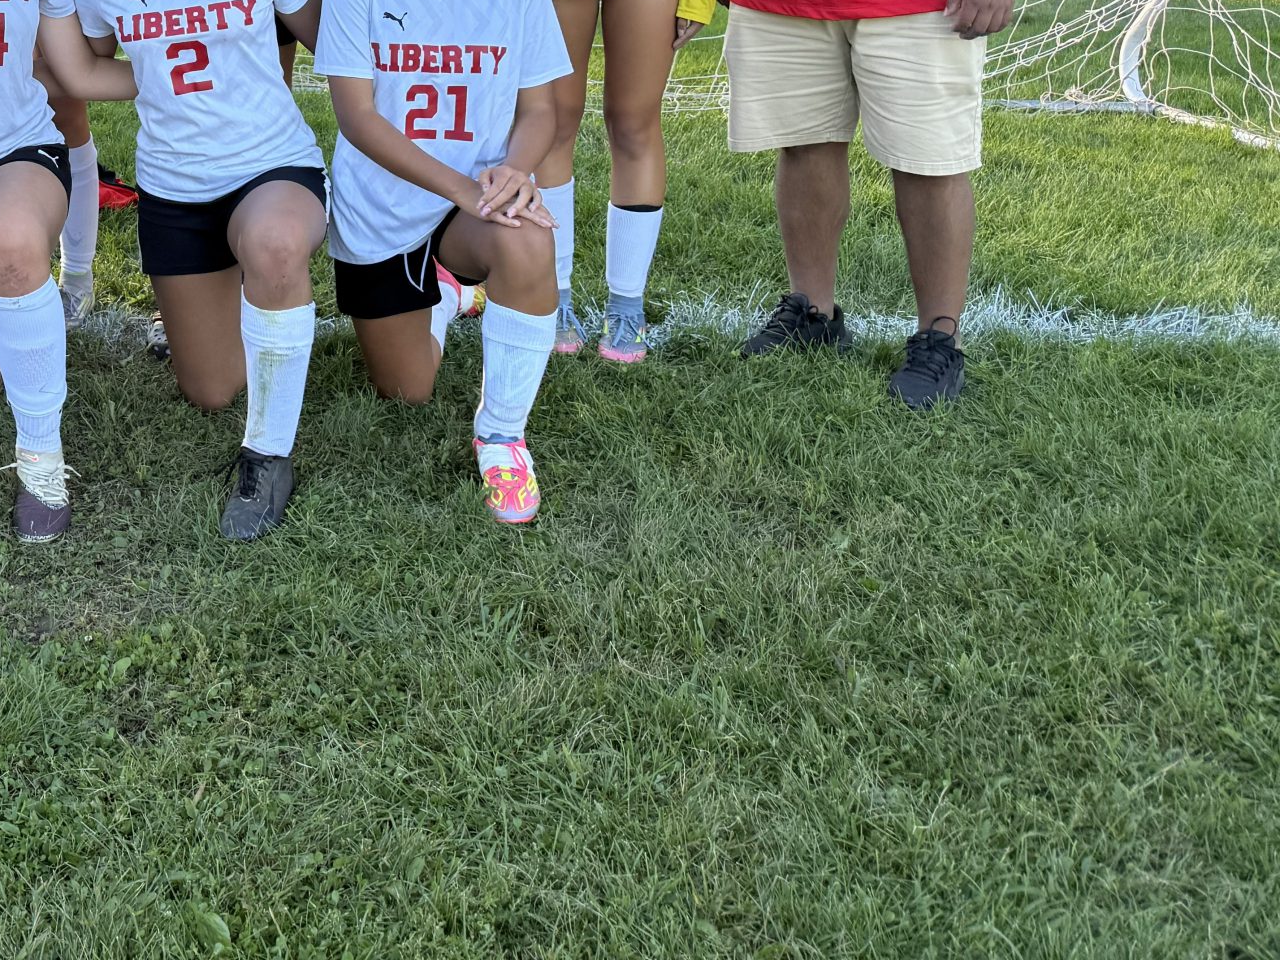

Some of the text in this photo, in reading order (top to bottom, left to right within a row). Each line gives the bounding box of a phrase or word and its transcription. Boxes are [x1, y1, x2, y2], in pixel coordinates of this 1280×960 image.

[166, 40, 214, 97] 2
[371, 42, 507, 75] LIBERTY
[405, 84, 474, 142] 21
